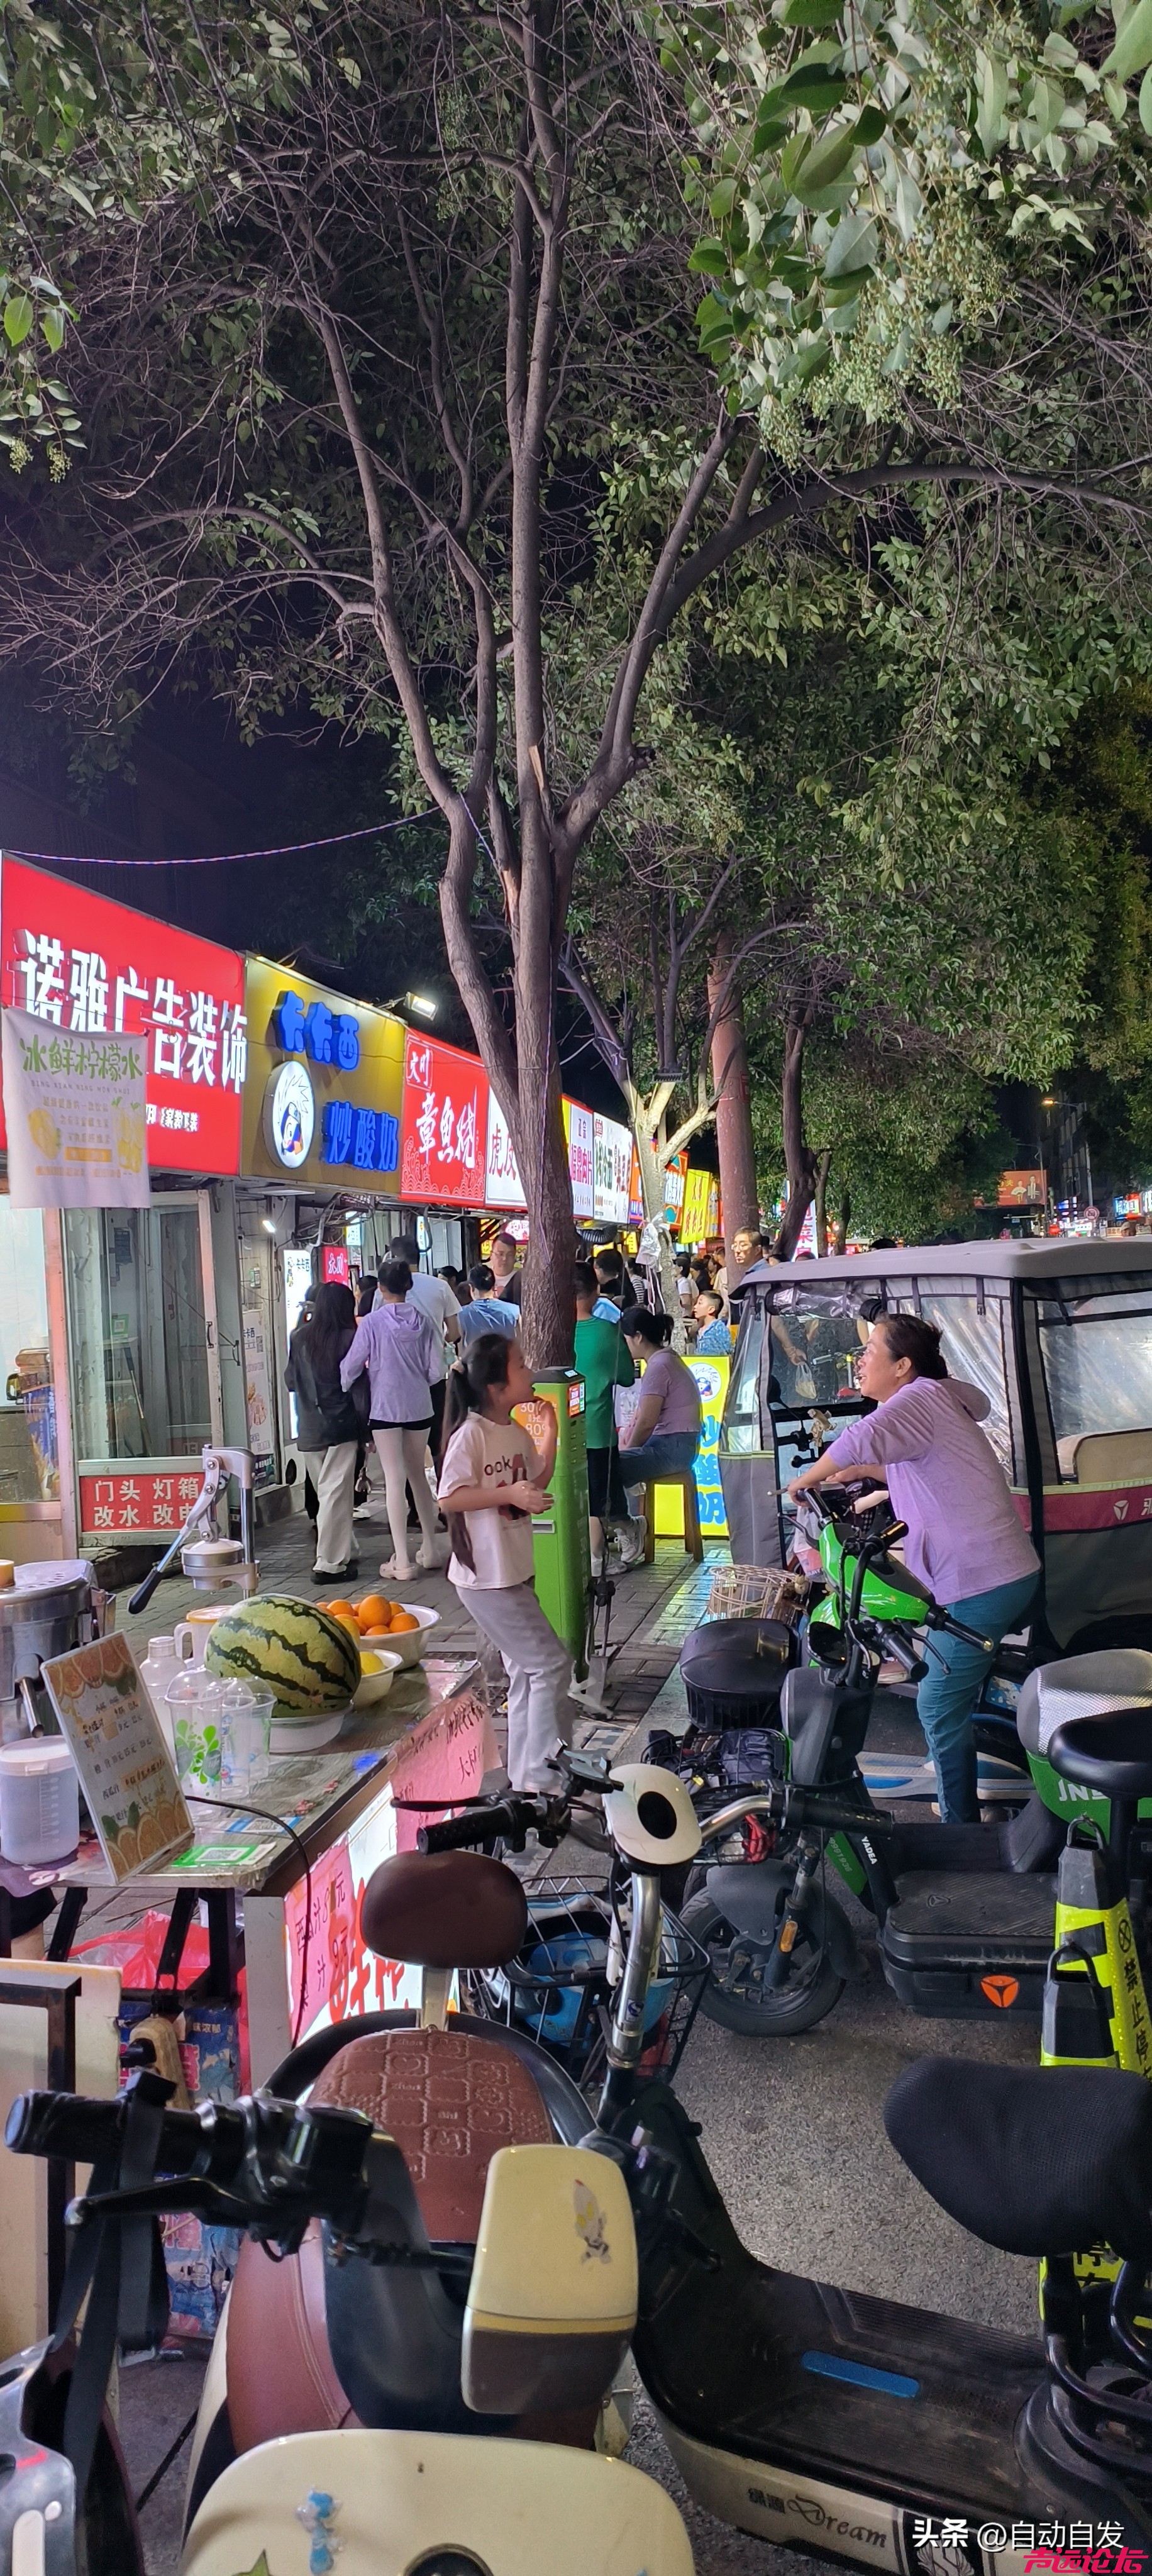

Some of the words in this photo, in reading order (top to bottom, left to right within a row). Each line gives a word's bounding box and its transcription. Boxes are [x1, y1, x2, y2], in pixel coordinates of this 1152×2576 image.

[19, 928, 248, 1094] 诺雅广告装饰
[279, 990, 359, 1070] 卡卡西
[19, 1034, 143, 1082] 冰鲜柠檬水
[328, 1102, 398, 1170] 炒酸奶
[416, 1085, 477, 1169] 章鱼烧
[571, 1143, 592, 1186] 福鼎肉片
[95, 1479, 141, 1502] 门头
[152, 1477, 199, 1500] 灯箱
[94, 1504, 140, 1528] 改水
[861, 1836, 878, 1865] YADEA
[787, 2493, 887, 2548] Dream
